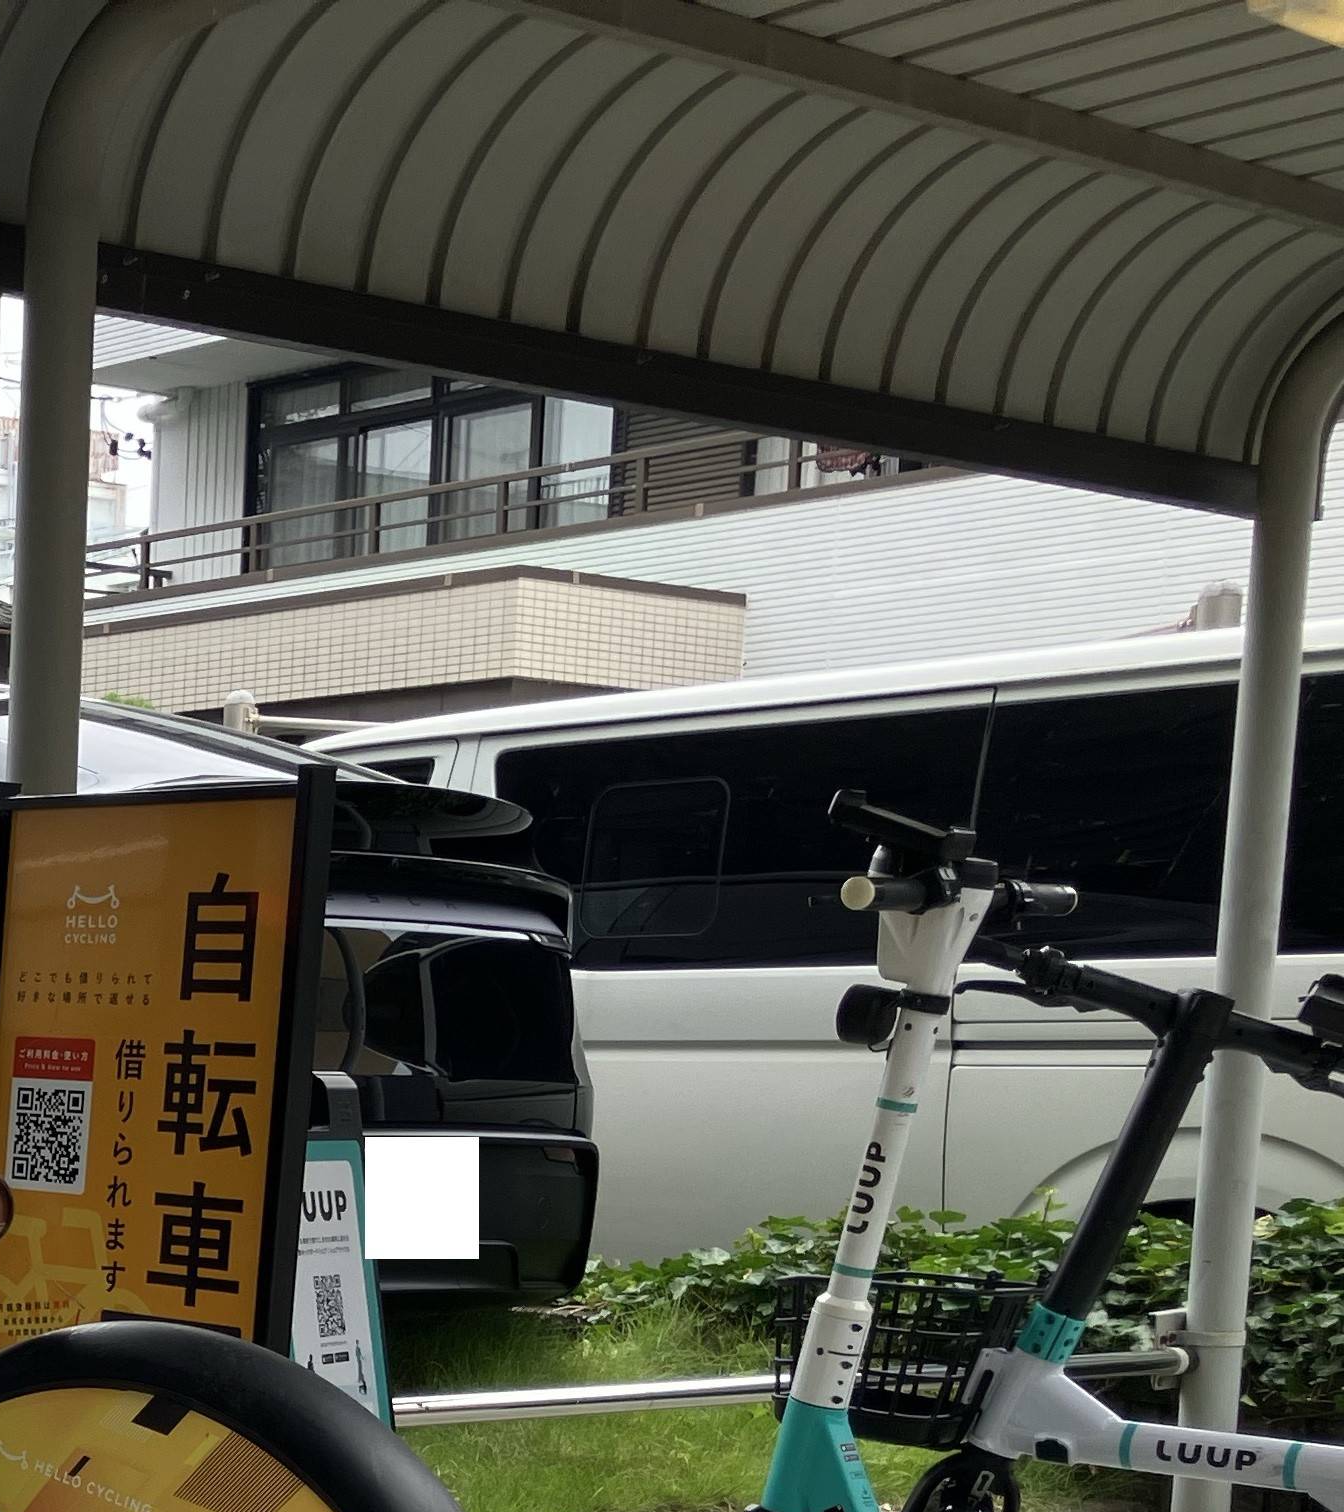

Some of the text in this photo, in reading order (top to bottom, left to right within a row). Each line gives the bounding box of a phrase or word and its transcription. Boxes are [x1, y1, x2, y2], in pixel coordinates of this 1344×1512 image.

[65, 914, 118, 929] HELLO
[64, 933, 117, 945] CYCLING
[146, 872, 260, 1308] 自転車
[101, 1038, 147, 1293] 借りられます
[847, 1141, 886, 1234] LUUP
[301, 1190, 348, 1223] UUP
[1156, 1439, 1257, 1471] LUUP
[34, 1460, 82, 1489] HELLO
